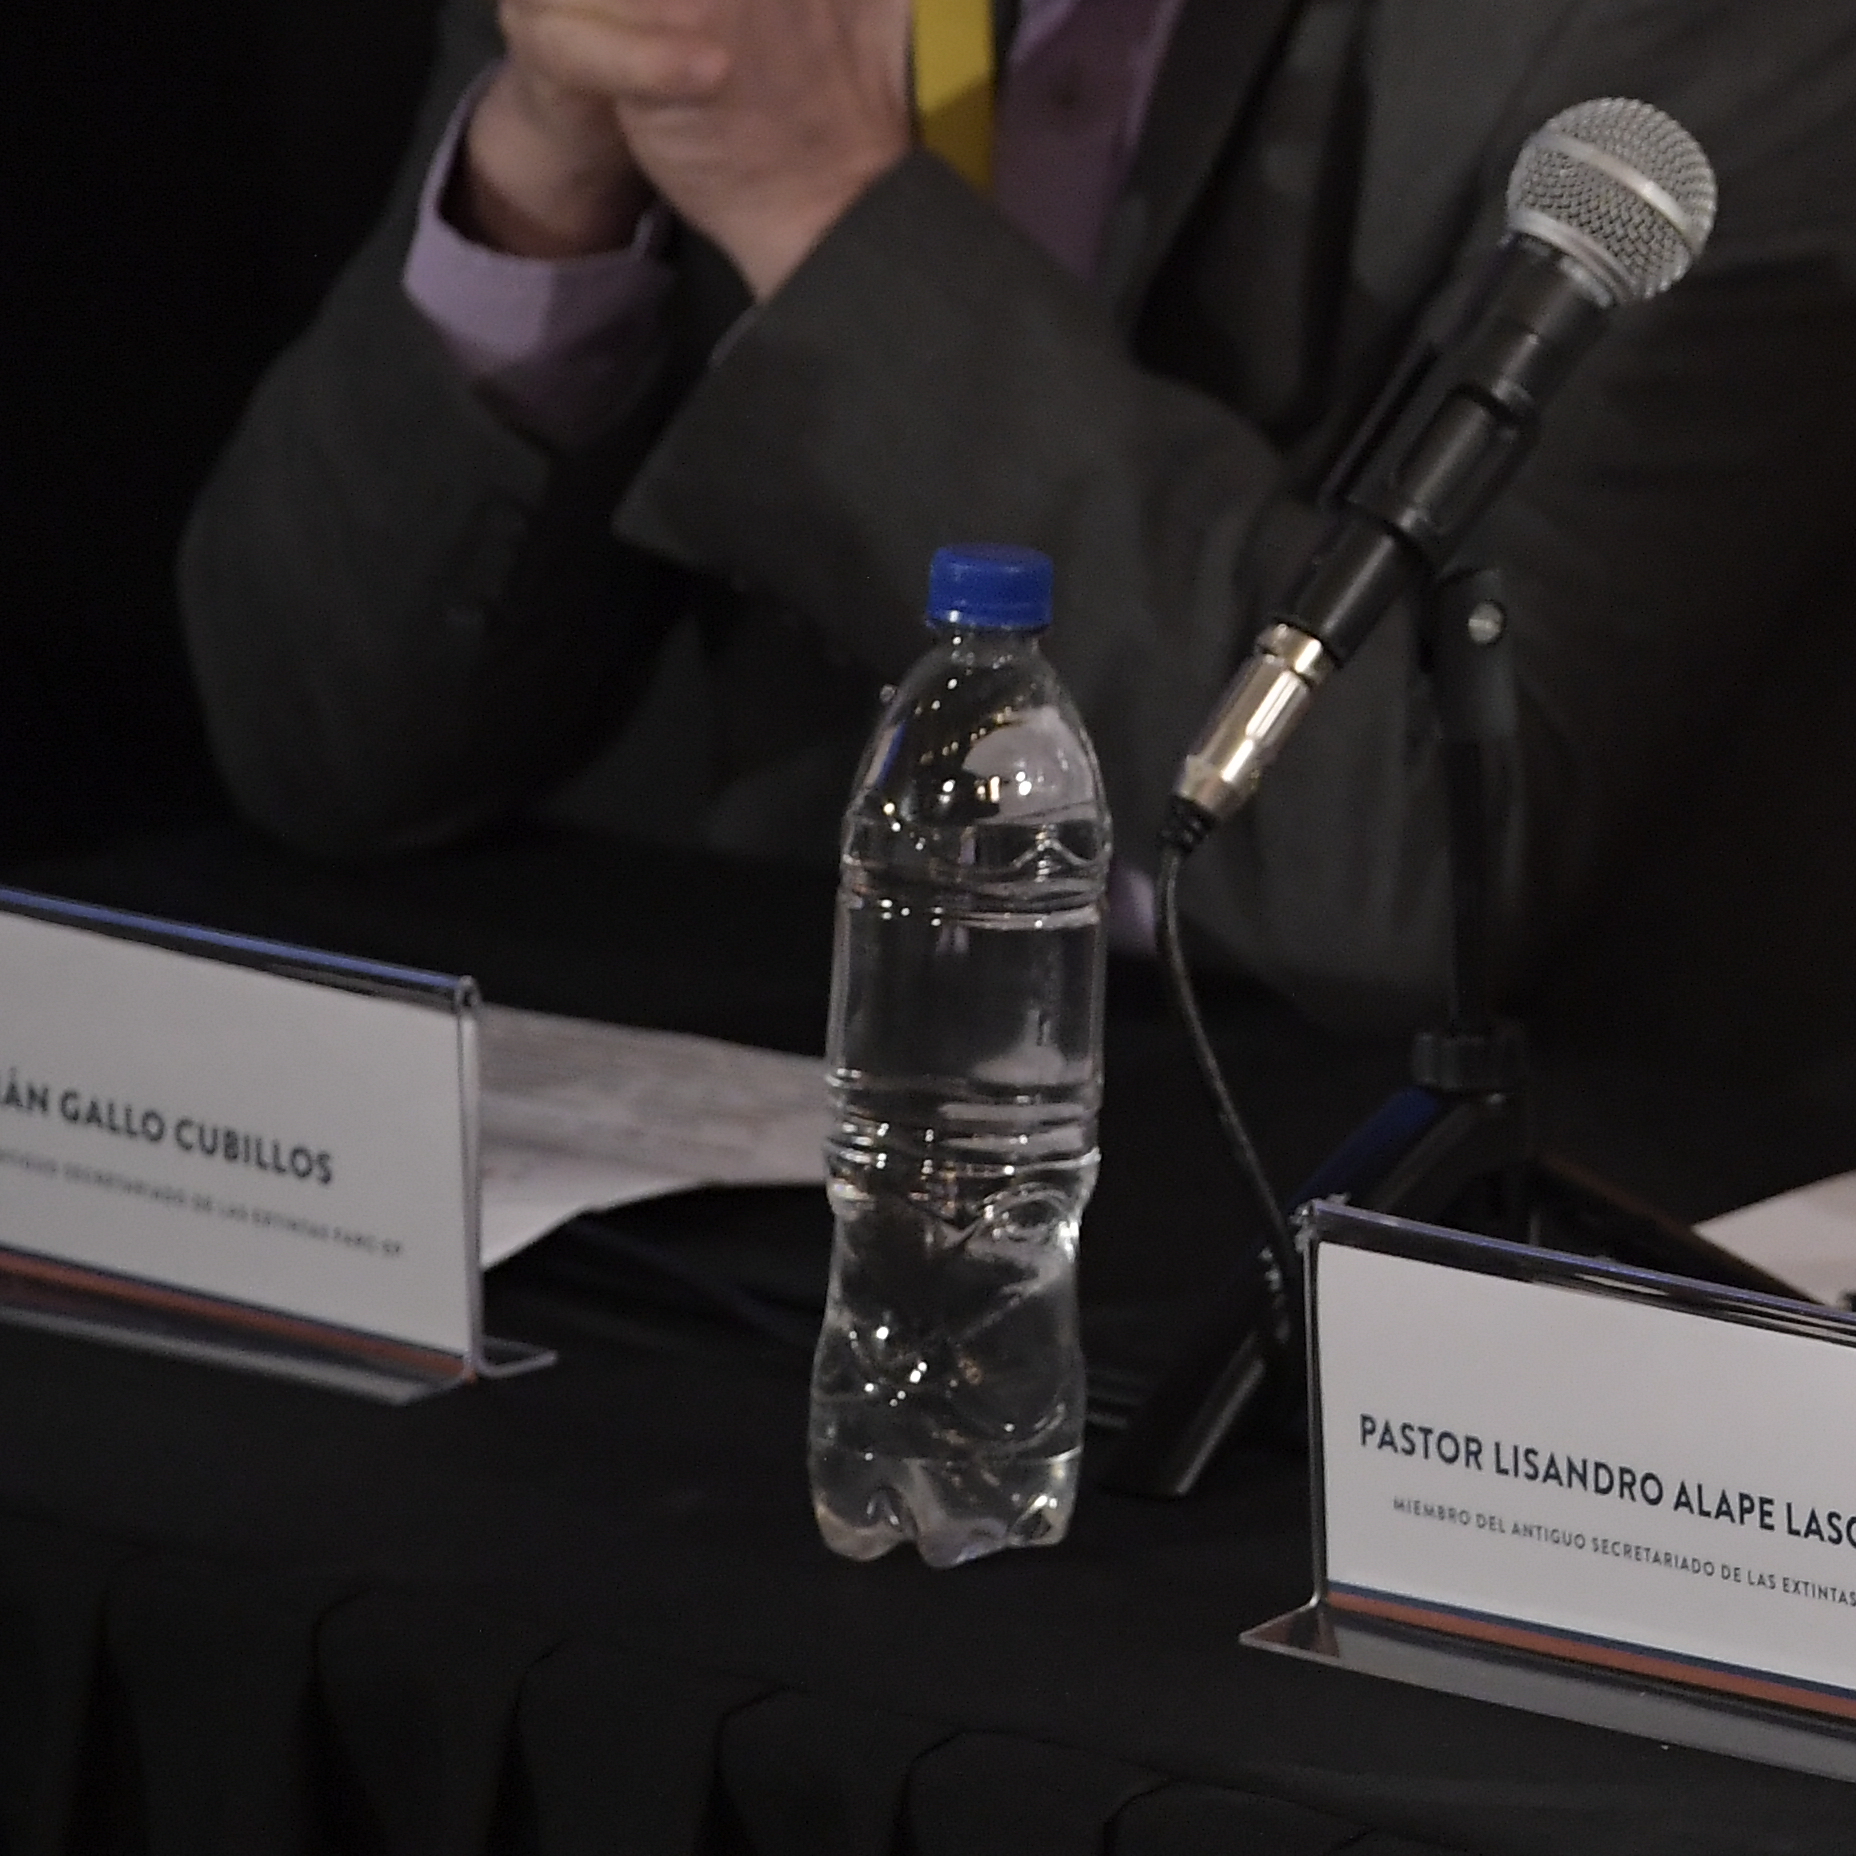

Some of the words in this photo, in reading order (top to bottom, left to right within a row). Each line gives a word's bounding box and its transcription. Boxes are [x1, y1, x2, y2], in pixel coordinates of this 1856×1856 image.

[0, 1067, 50, 1115] ÁN
[59, 1088, 167, 1144] GALLO
[174, 1116, 334, 1187] CUBILLOS
[1359, 1412, 1484, 1473] PASTOR
[1493, 1440, 1665, 1507] LISANDRO
[1672, 1479, 1776, 1533] ALAPE
[1393, 1497, 1471, 1527] MIEMBRO
[1475, 1512, 1506, 1534] DEL
[1510, 1521, 1587, 1551] ANTIGUO
[1590, 1536, 1716, 1578] SECRETARIADO
[1720, 1562, 1743, 1584] DE
[1746, 1569, 1777, 1591] LAS
